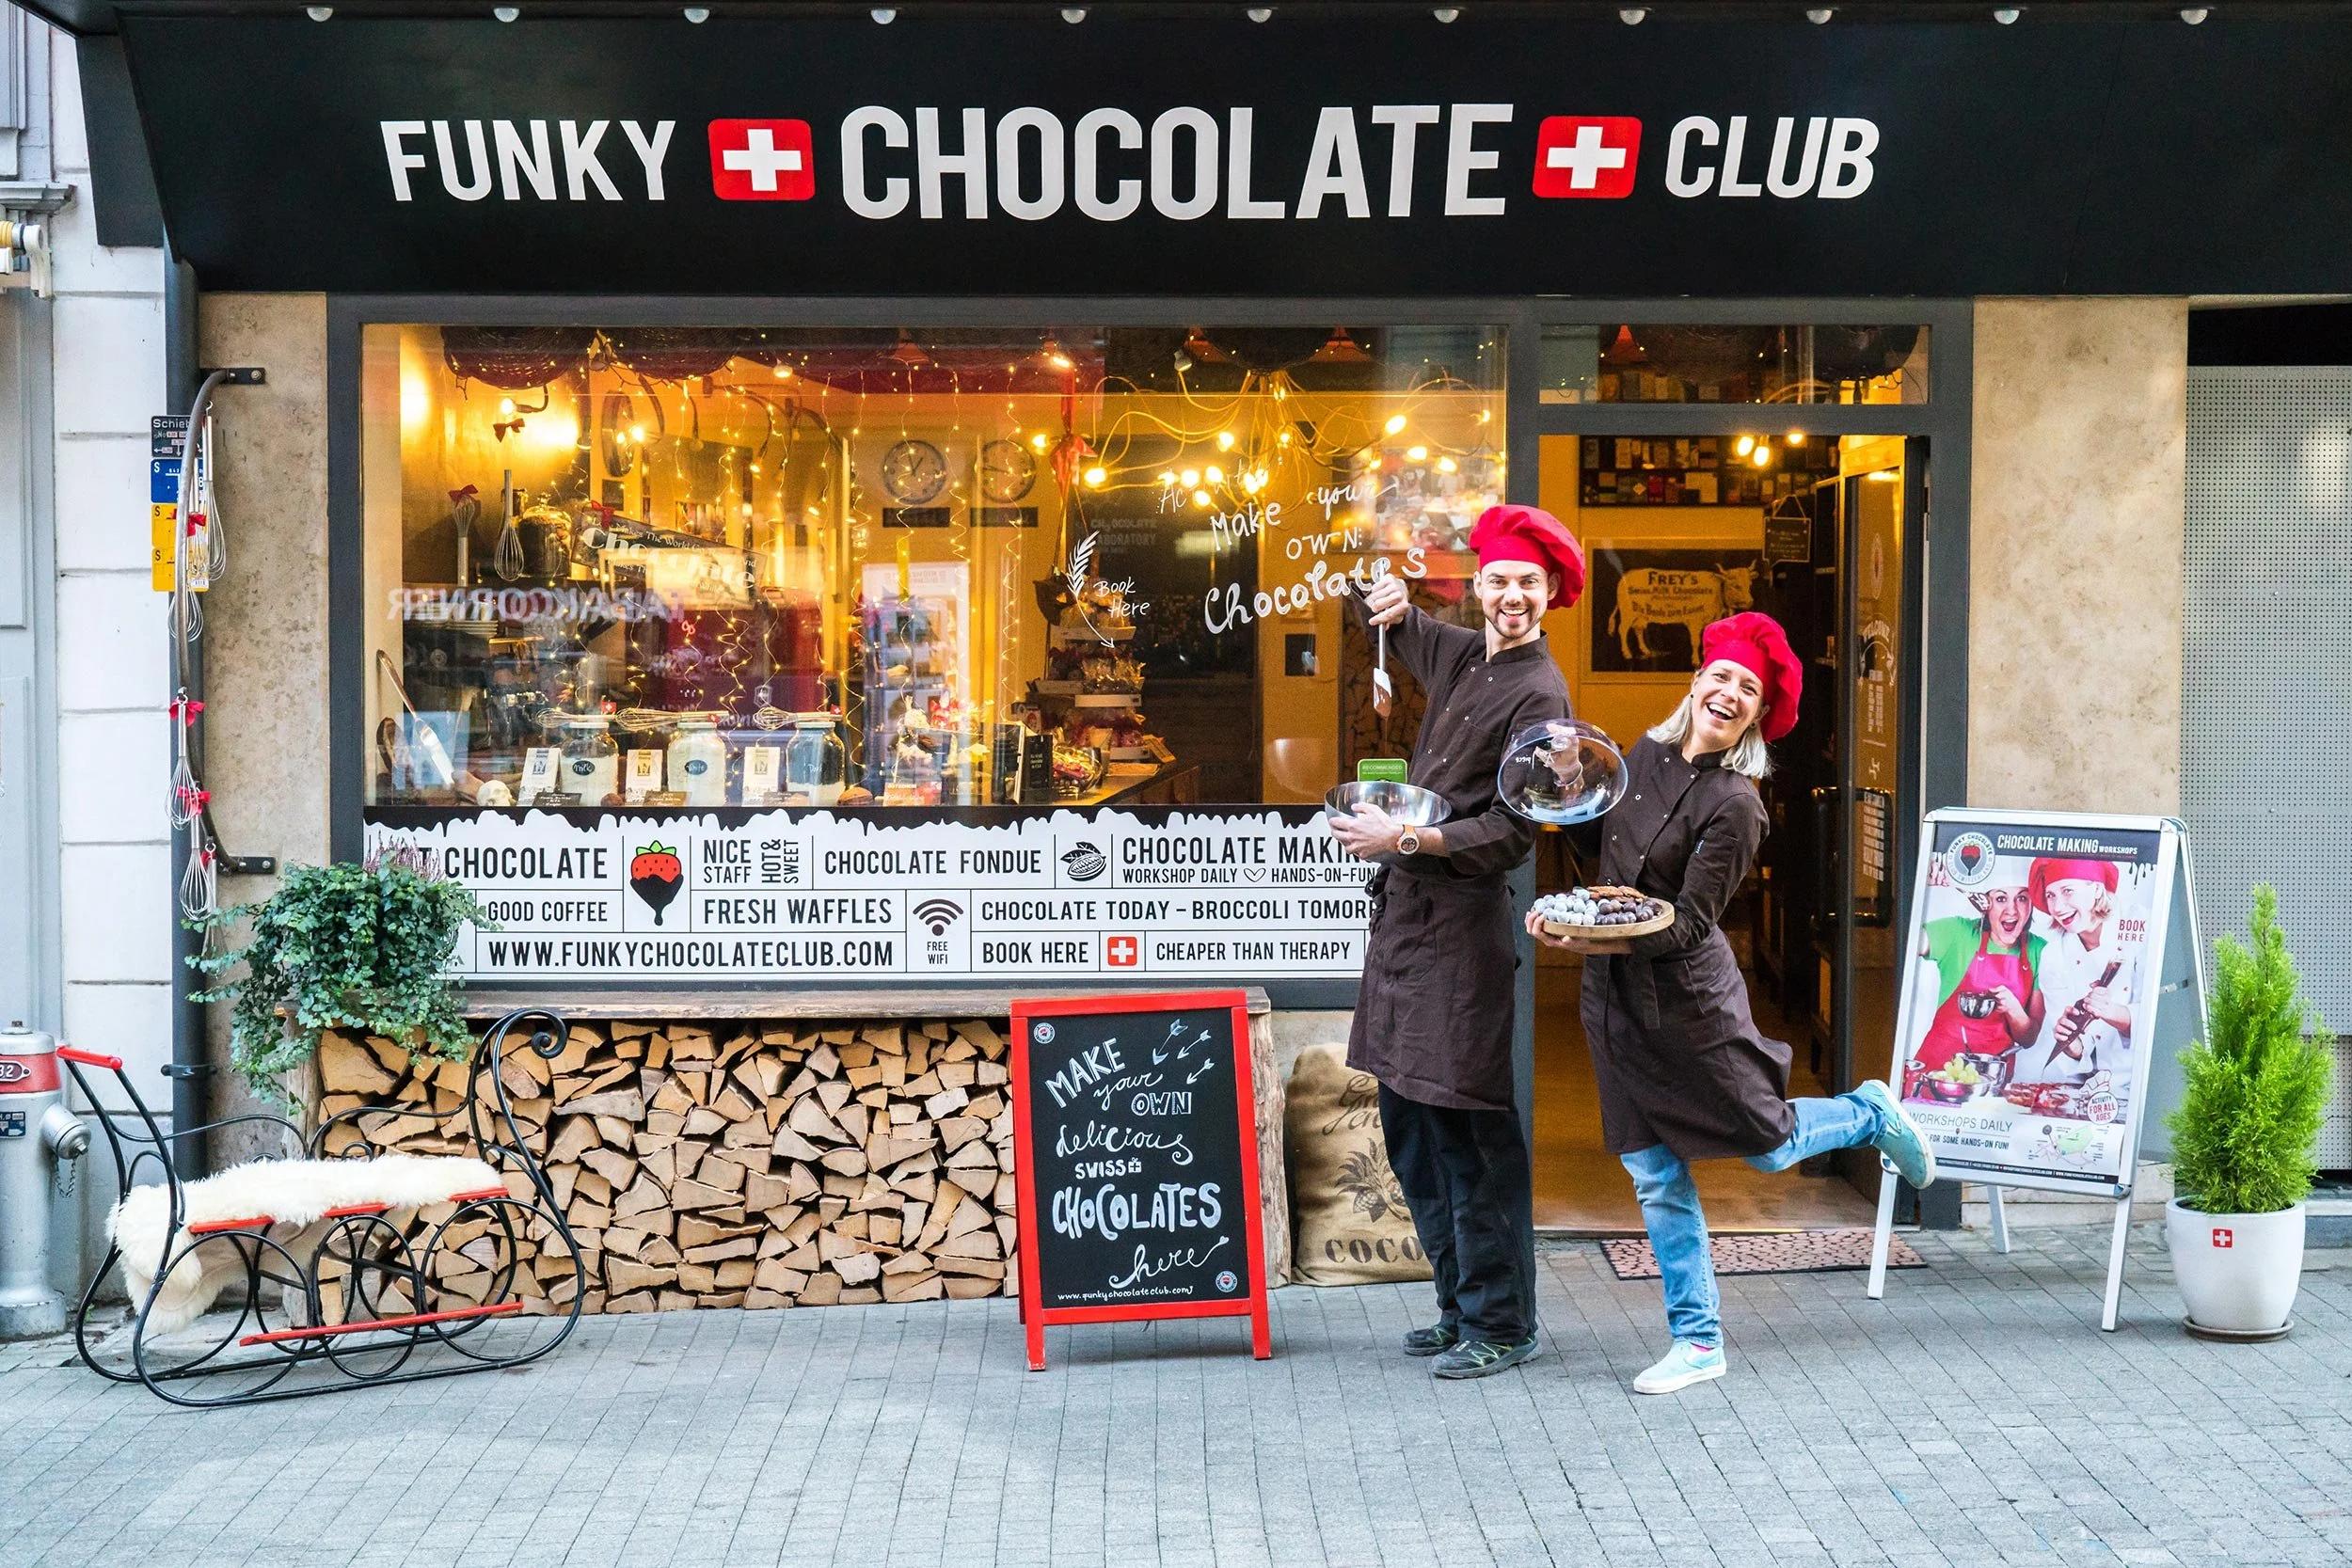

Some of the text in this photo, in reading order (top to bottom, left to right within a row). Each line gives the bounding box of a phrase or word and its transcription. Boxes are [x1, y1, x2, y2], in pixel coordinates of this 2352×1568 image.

[379, 104, 1881, 221] FUNKY CHOCOLATE CLUB
[153, 462, 161, 473] S
[154, 506, 161, 516] S
[1317, 482, 1397, 521] your
[1210, 501, 1281, 551] Make
[155, 550, 162, 561] S
[1093, 577, 1136, 597] Book
[1108, 599, 1151, 618] Here
[704, 839, 752, 863] NICE
[1122, 835, 1266, 865] CHOCOLATE
[1997, 834, 2138, 855] CHOCOLATE MAKING WORKSHOPS
[445, 847, 608, 879] CHOCOLATE
[783, 839, 800, 884] SWEET
[824, 848, 1041, 875] CHOCOLATE FONDUE
[704, 865, 752, 884] STAFF
[1122, 867, 1196, 884] WORKSHOP
[1200, 867, 1238, 884] DAILY
[487, 900, 608, 923] GOOD COFFEE
[704, 897, 893, 925] FRESH WAFFLES
[981, 900, 1097, 922] CHOCOLATE
[1105, 899, 1169, 921] TODAY
[1192, 898, 1290, 921] BROCCOLI
[2119, 918, 2146, 932] BOOK
[927, 941, 948, 952] FREE
[2118, 932, 2144, 942] HERE
[488, 940, 893, 968] WWW.FUNKYCHOCOLATECLUB.COM
[928, 953, 948, 965] WIFI
[982, 941, 1089, 964] BOOK HERE
[1156, 941, 1351, 961] CHEAPER THAN THERAPY
[1044, 1037, 1126, 1109] MAKE
[1093, 1072, 1164, 1111] your
[2090, 1095, 2113, 1105] ACTIVITY
[1131, 1090, 1192, 1117] OWN
[2089, 1102, 2116, 1115] FOR ALL
[1979, 1117, 2014, 1132] DAILY
[2095, 1112, 2112, 1123] AGES
[1056, 1119, 1194, 1165] delicious
[1930, 1133, 1940, 1144] FOR
[1942, 1134, 1959, 1146] SOME
[1961, 1136, 1994, 1148] HANDS-ON
[1994, 1139, 2010, 1149] FUN!
[1074, 1159, 1127, 1180] SWISS
[1052, 1182, 1222, 1241] CHOCOLATES
[1108, 1236, 1230, 1289] here
